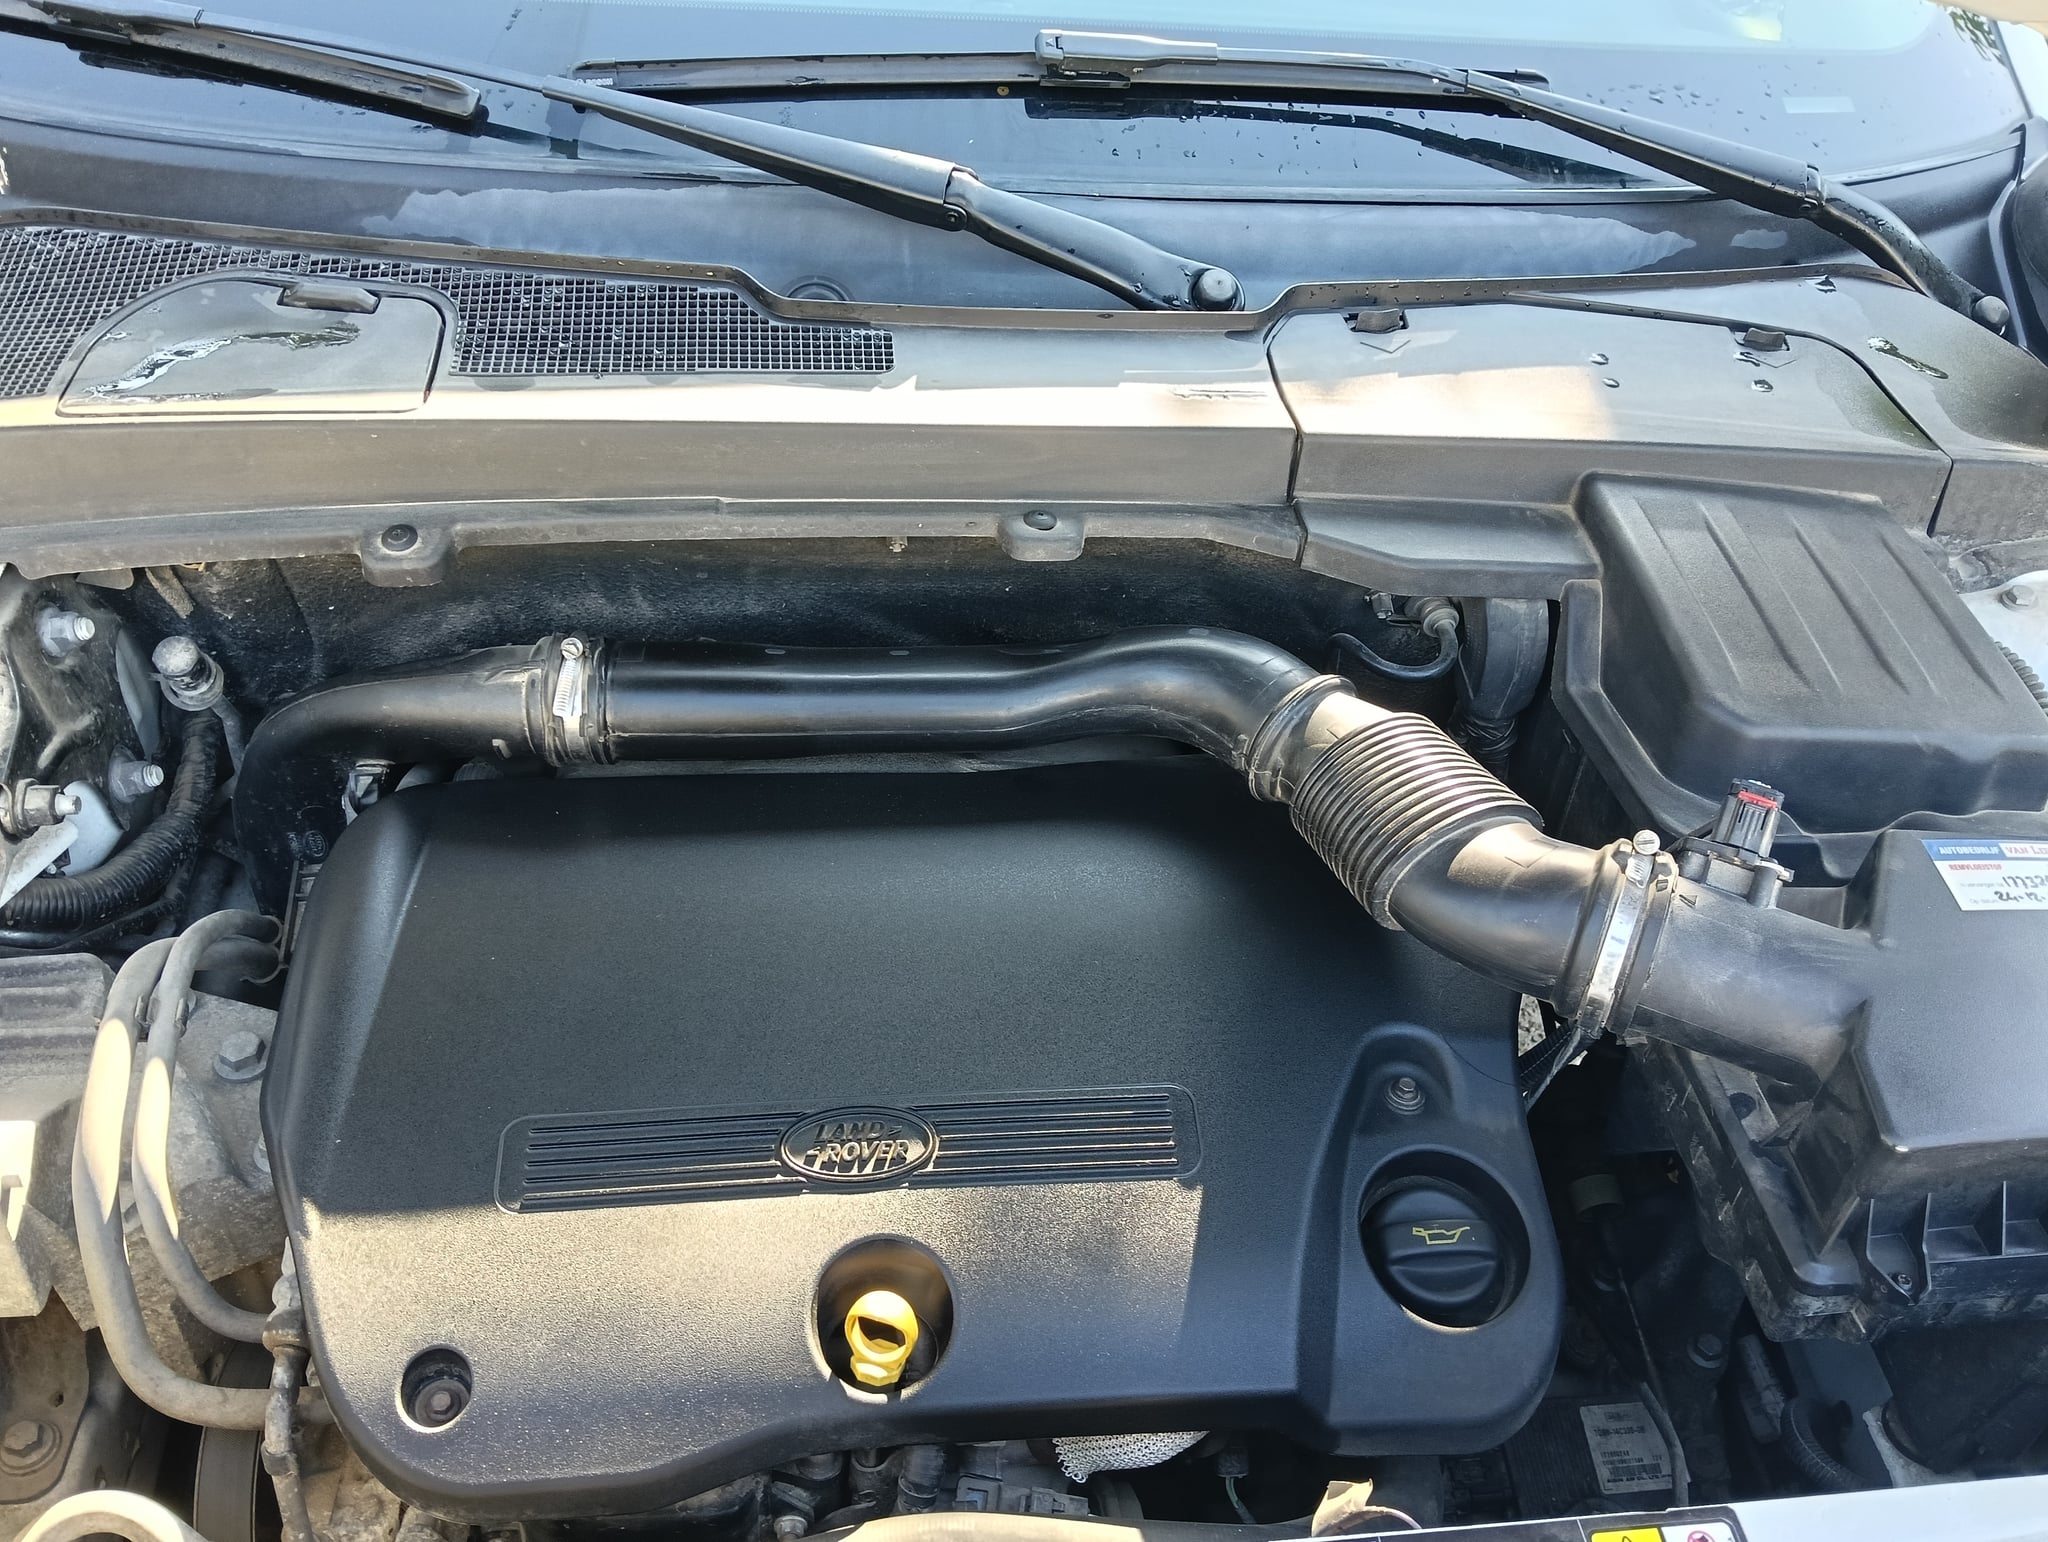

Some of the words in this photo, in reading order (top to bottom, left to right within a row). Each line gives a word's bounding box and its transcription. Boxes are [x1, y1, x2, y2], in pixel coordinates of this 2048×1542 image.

[1938, 846, 2000, 855] AUTOBEDRIJF
[815, 1120, 886, 1143] LAND
[822, 1139, 910, 1163] ROVER
